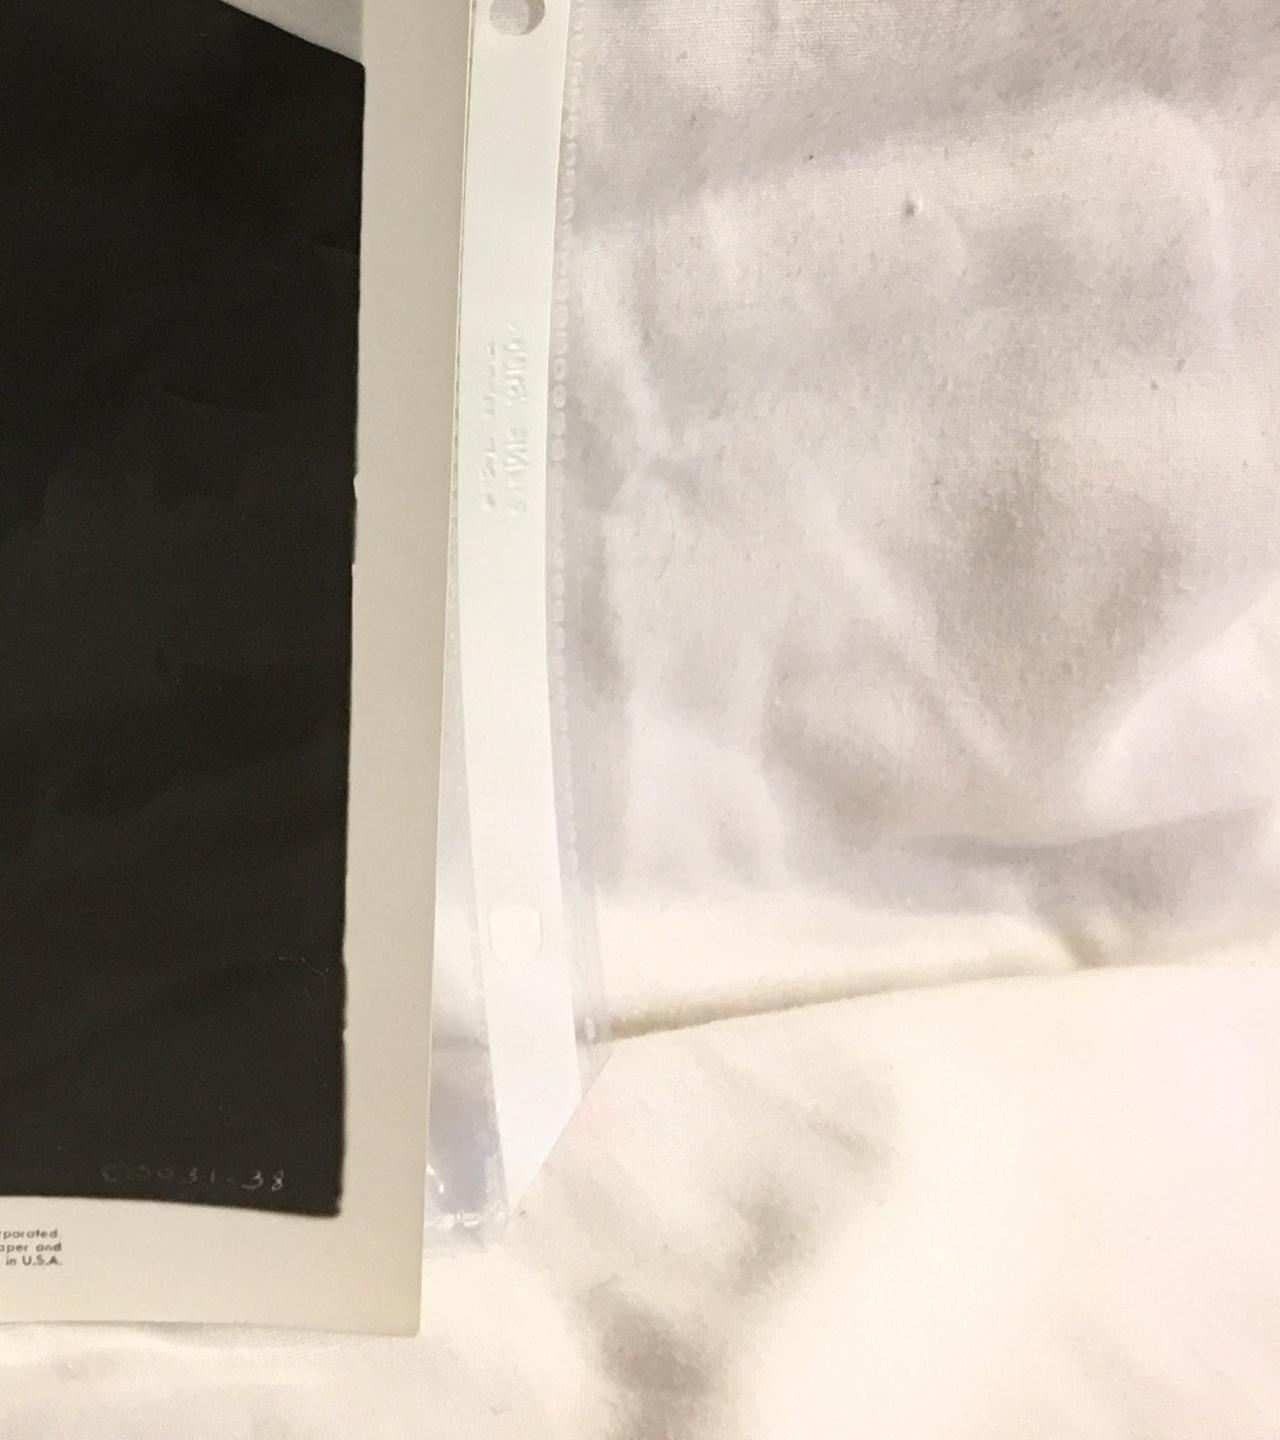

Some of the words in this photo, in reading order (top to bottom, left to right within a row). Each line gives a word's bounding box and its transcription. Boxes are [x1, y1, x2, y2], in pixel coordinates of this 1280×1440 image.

[35, 1242, 62, 1252] and
[6, 1257, 17, 1266] in
[22, 1255, 64, 1266] U.S.A.
